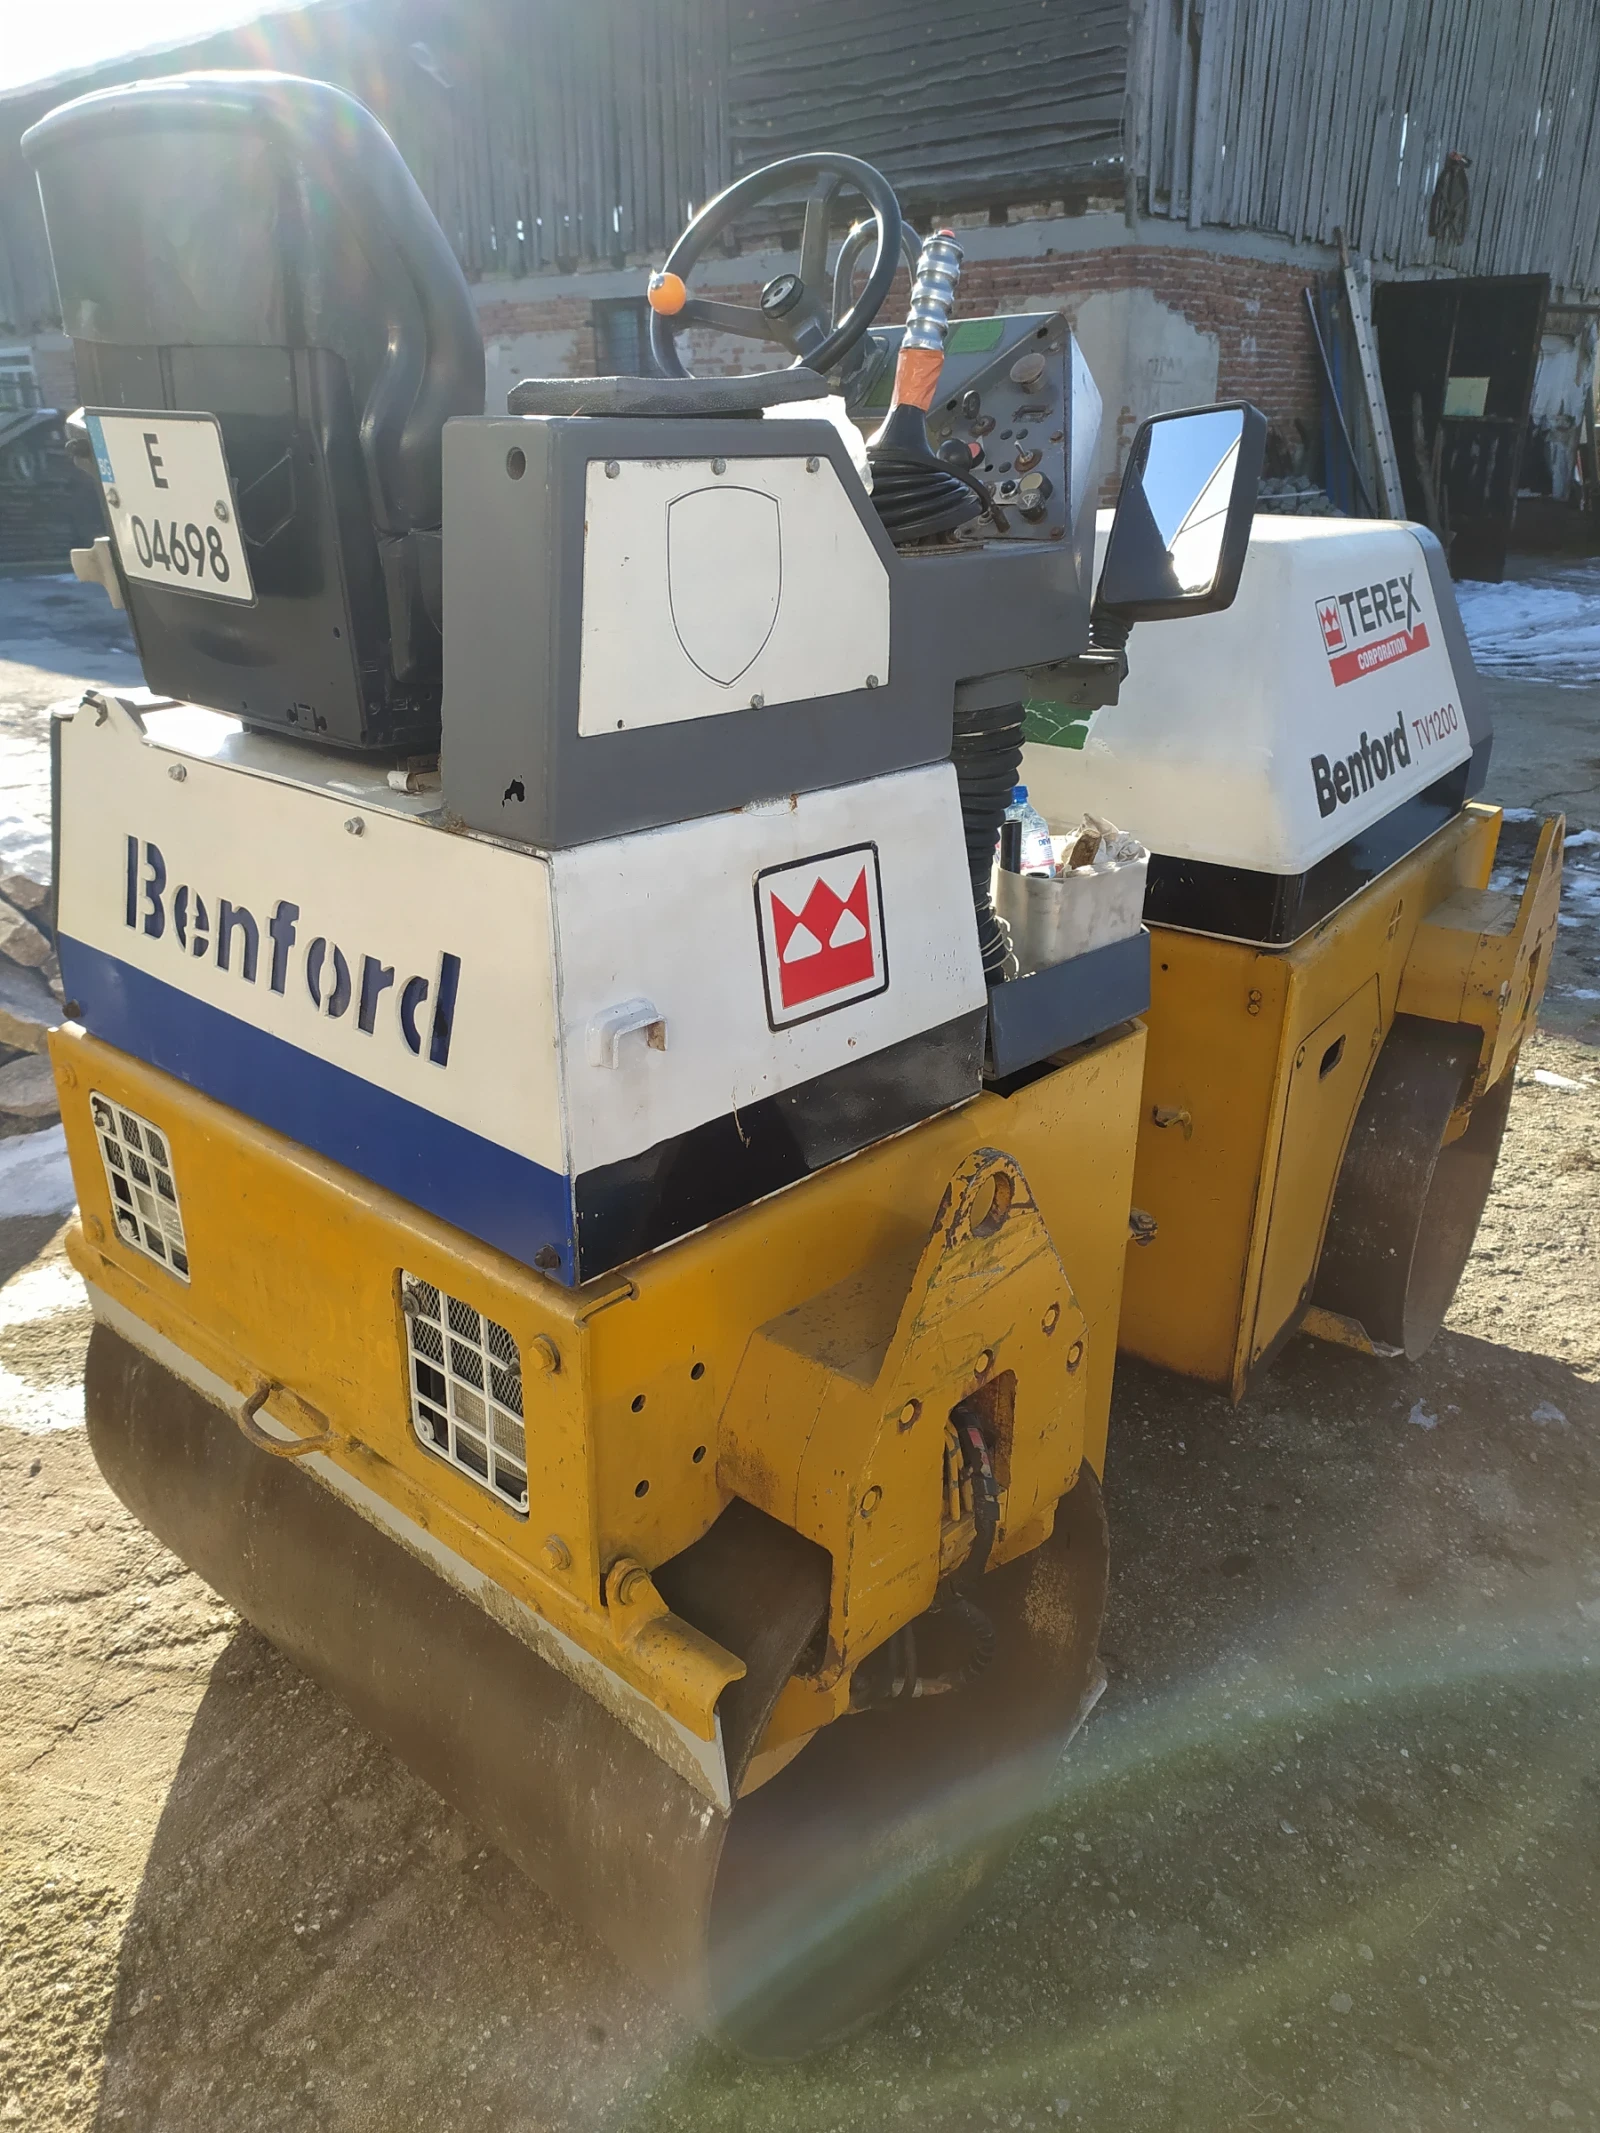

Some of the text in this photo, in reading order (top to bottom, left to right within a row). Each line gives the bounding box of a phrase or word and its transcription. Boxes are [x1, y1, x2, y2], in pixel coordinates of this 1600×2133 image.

[97, 457, 111, 476] BG
[143, 432, 169, 489] E
[131, 515, 230, 583] 04698
[1339, 571, 1421, 634] TEREX
[1357, 635, 1408, 671] CORPORATION
[1310, 703, 1459, 819] Benford TV1200
[123, 834, 461, 1069] Benford
